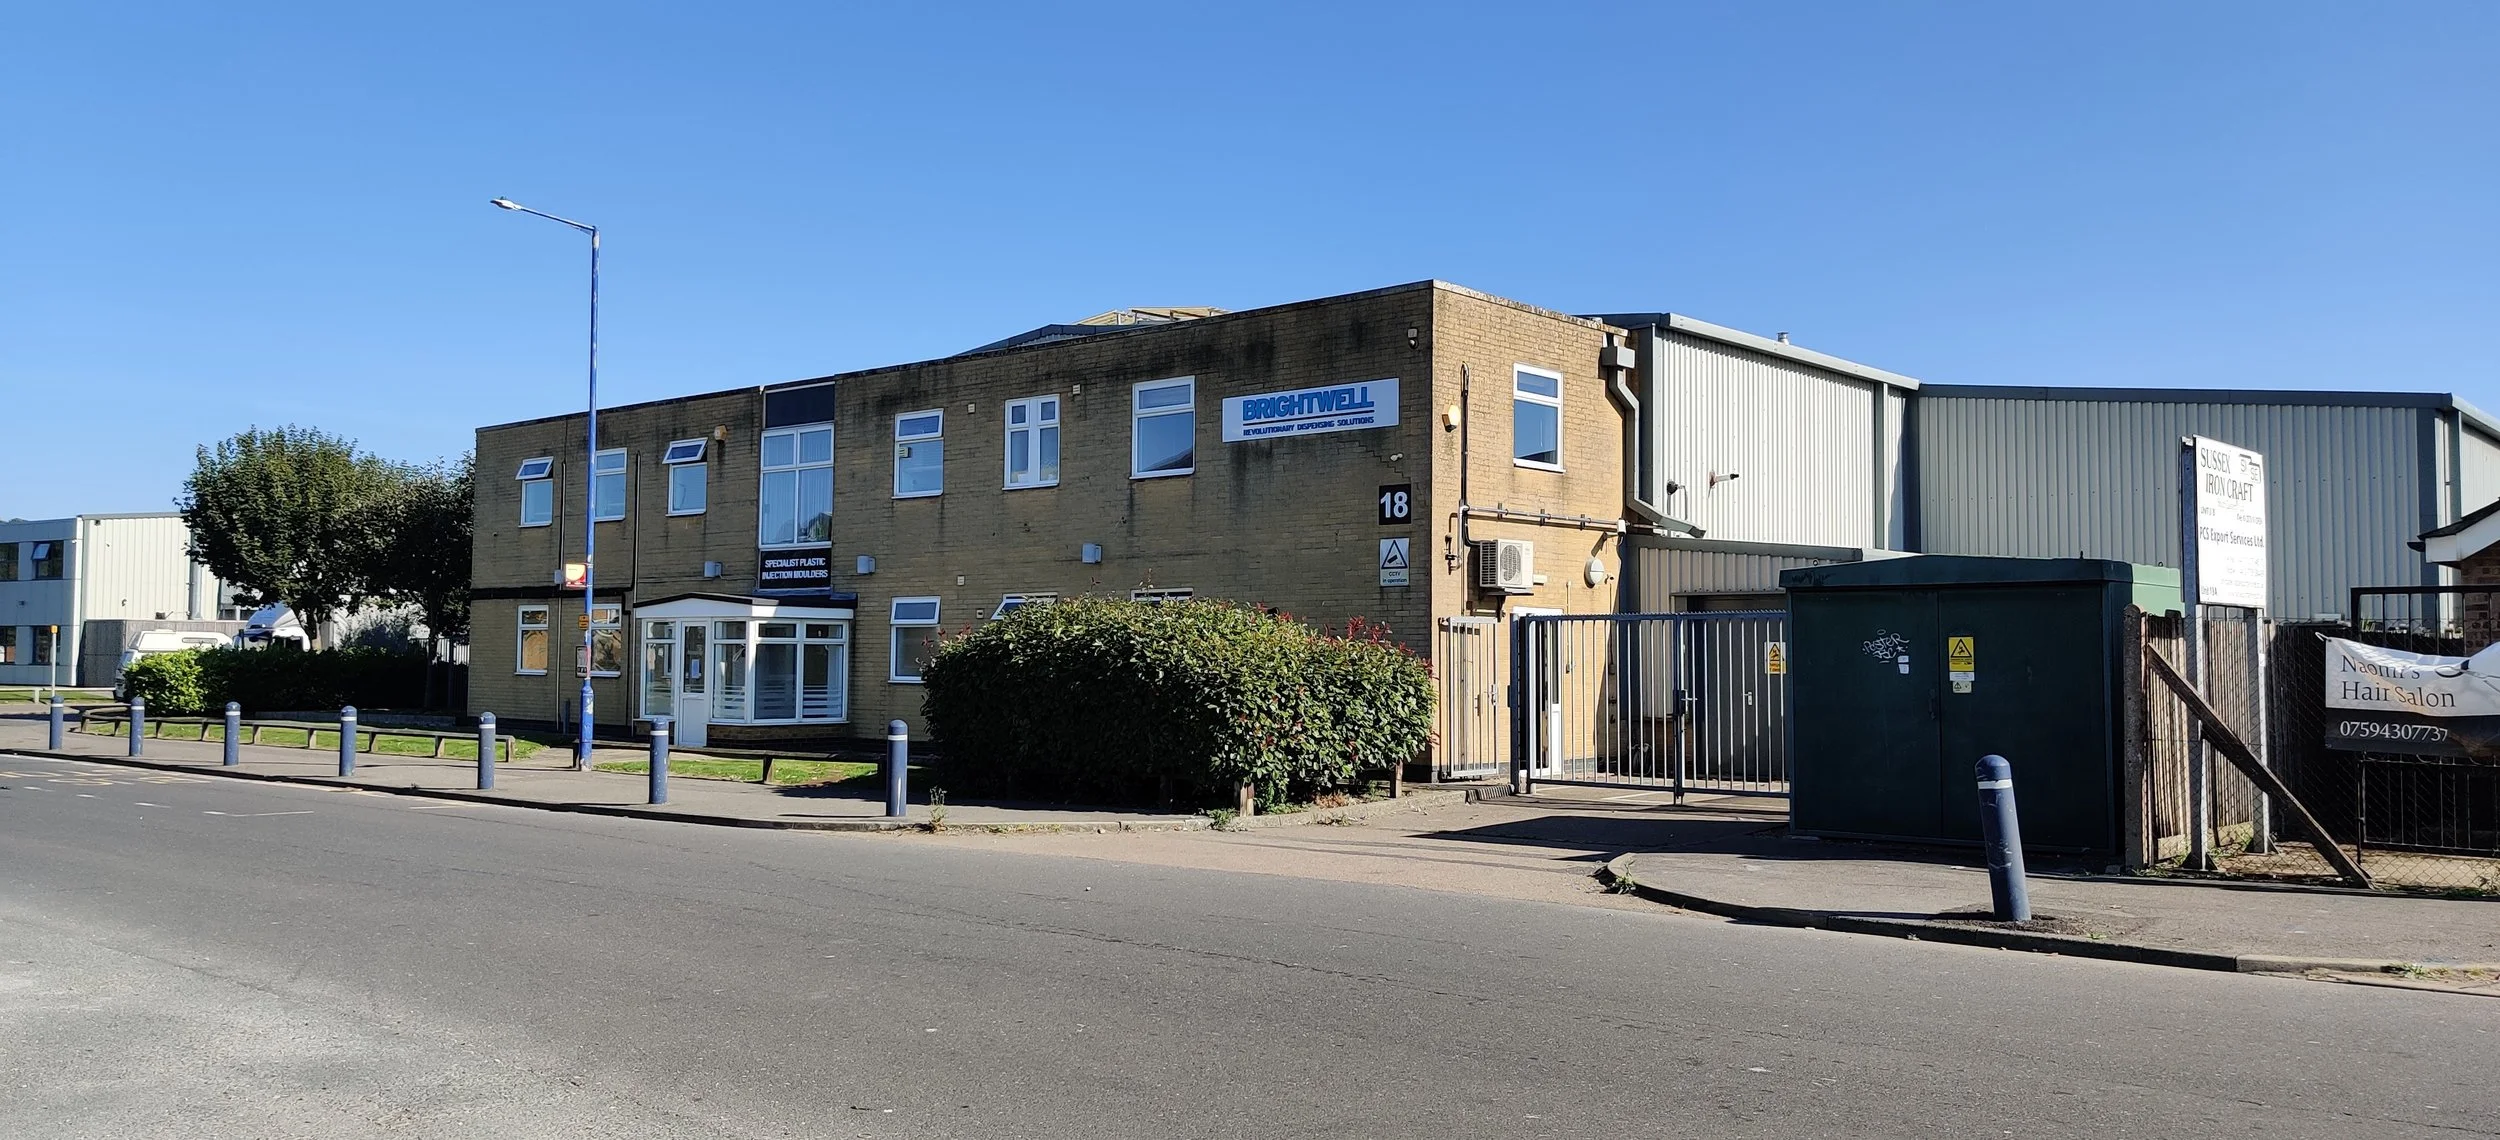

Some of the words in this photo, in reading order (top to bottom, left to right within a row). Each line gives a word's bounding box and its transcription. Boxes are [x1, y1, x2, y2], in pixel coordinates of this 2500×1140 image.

[1243, 386, 1375, 421] BRIGHTWELL
[1243, 424, 1295, 436] REVOLUTIONARY
[1297, 420, 1335, 431] DISPENSING
[1337, 416, 1375, 427] SOLUTIONS
[2200, 447, 2231, 474] SUSSEX
[2205, 473, 2226, 497] IRON
[2226, 478, 2254, 502] CRAFT
[1380, 491, 1409, 518] 18
[2199, 526, 2210, 541] PCS
[2210, 528, 2229, 545] Export
[2229, 531, 2253, 547] Services
[762, 570, 793, 580] INJECTION
[793, 569, 829, 579] MOULDERS
[765, 558, 799, 568] SPECIALIST
[800, 557, 826, 567] PLASTIC
[2341, 655, 2420, 680] Naomi's
[2341, 681, 2390, 702] Hair
[2394, 686, 2456, 708] Salon
[2340, 720, 2448, 742] 07594307737
